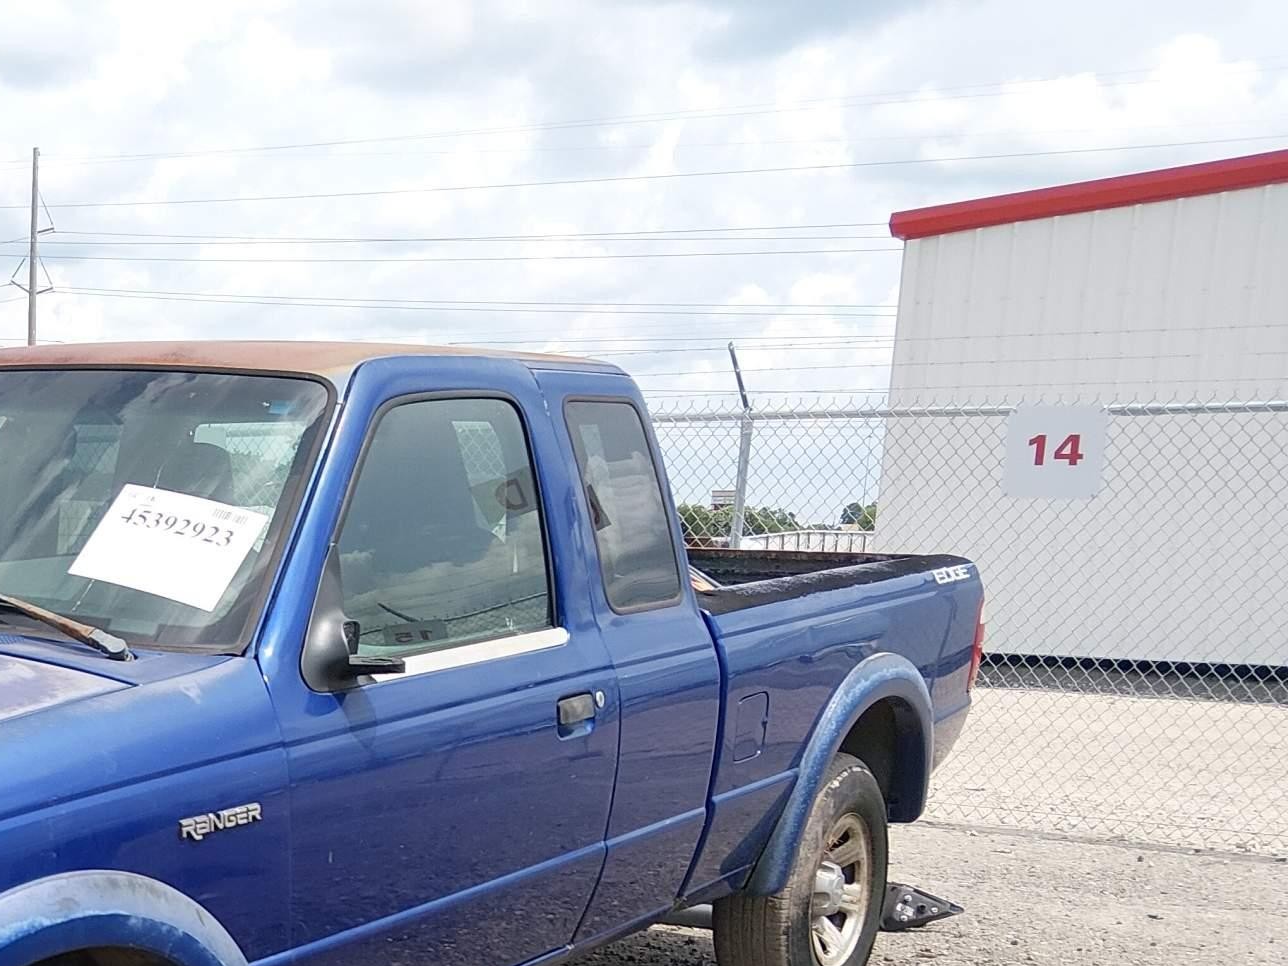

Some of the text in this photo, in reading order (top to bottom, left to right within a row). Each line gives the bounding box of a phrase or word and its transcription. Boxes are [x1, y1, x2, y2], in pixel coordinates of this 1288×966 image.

[1028, 434, 1084, 466] 14
[121, 508, 234, 546] 45392923
[178, 802, 262, 840] RANGER
